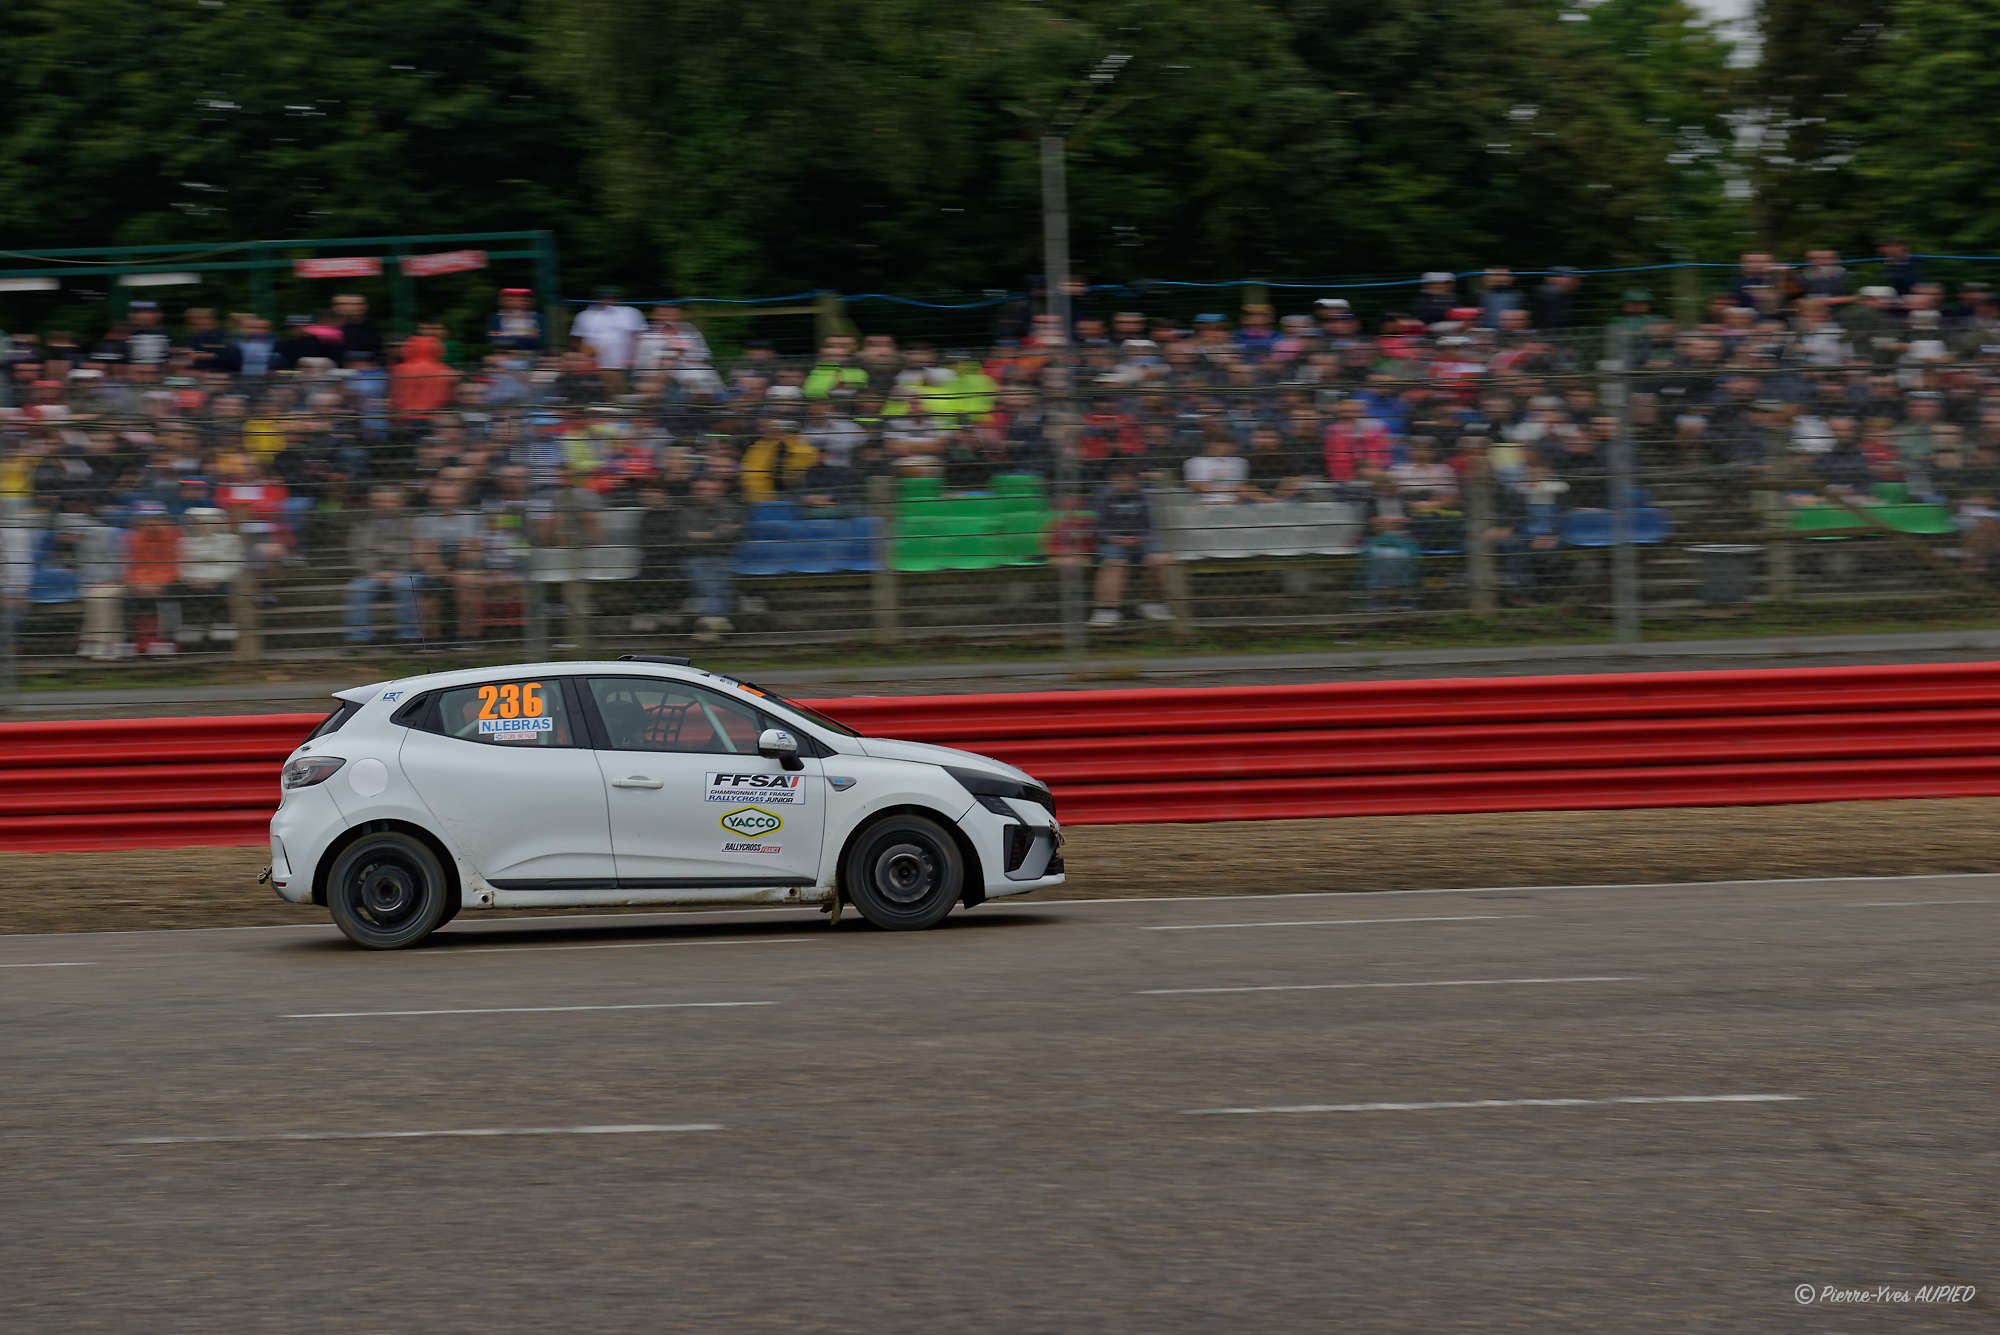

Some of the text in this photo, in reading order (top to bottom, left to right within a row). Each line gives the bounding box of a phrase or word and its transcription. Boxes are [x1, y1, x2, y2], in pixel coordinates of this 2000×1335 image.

[478, 682, 543, 720] 236
[482, 718, 551, 732] N.LEBRAS
[713, 774, 789, 788] FFSA
[728, 817, 776, 828] YACCO
[724, 843, 761, 851] RALLYCROSS
